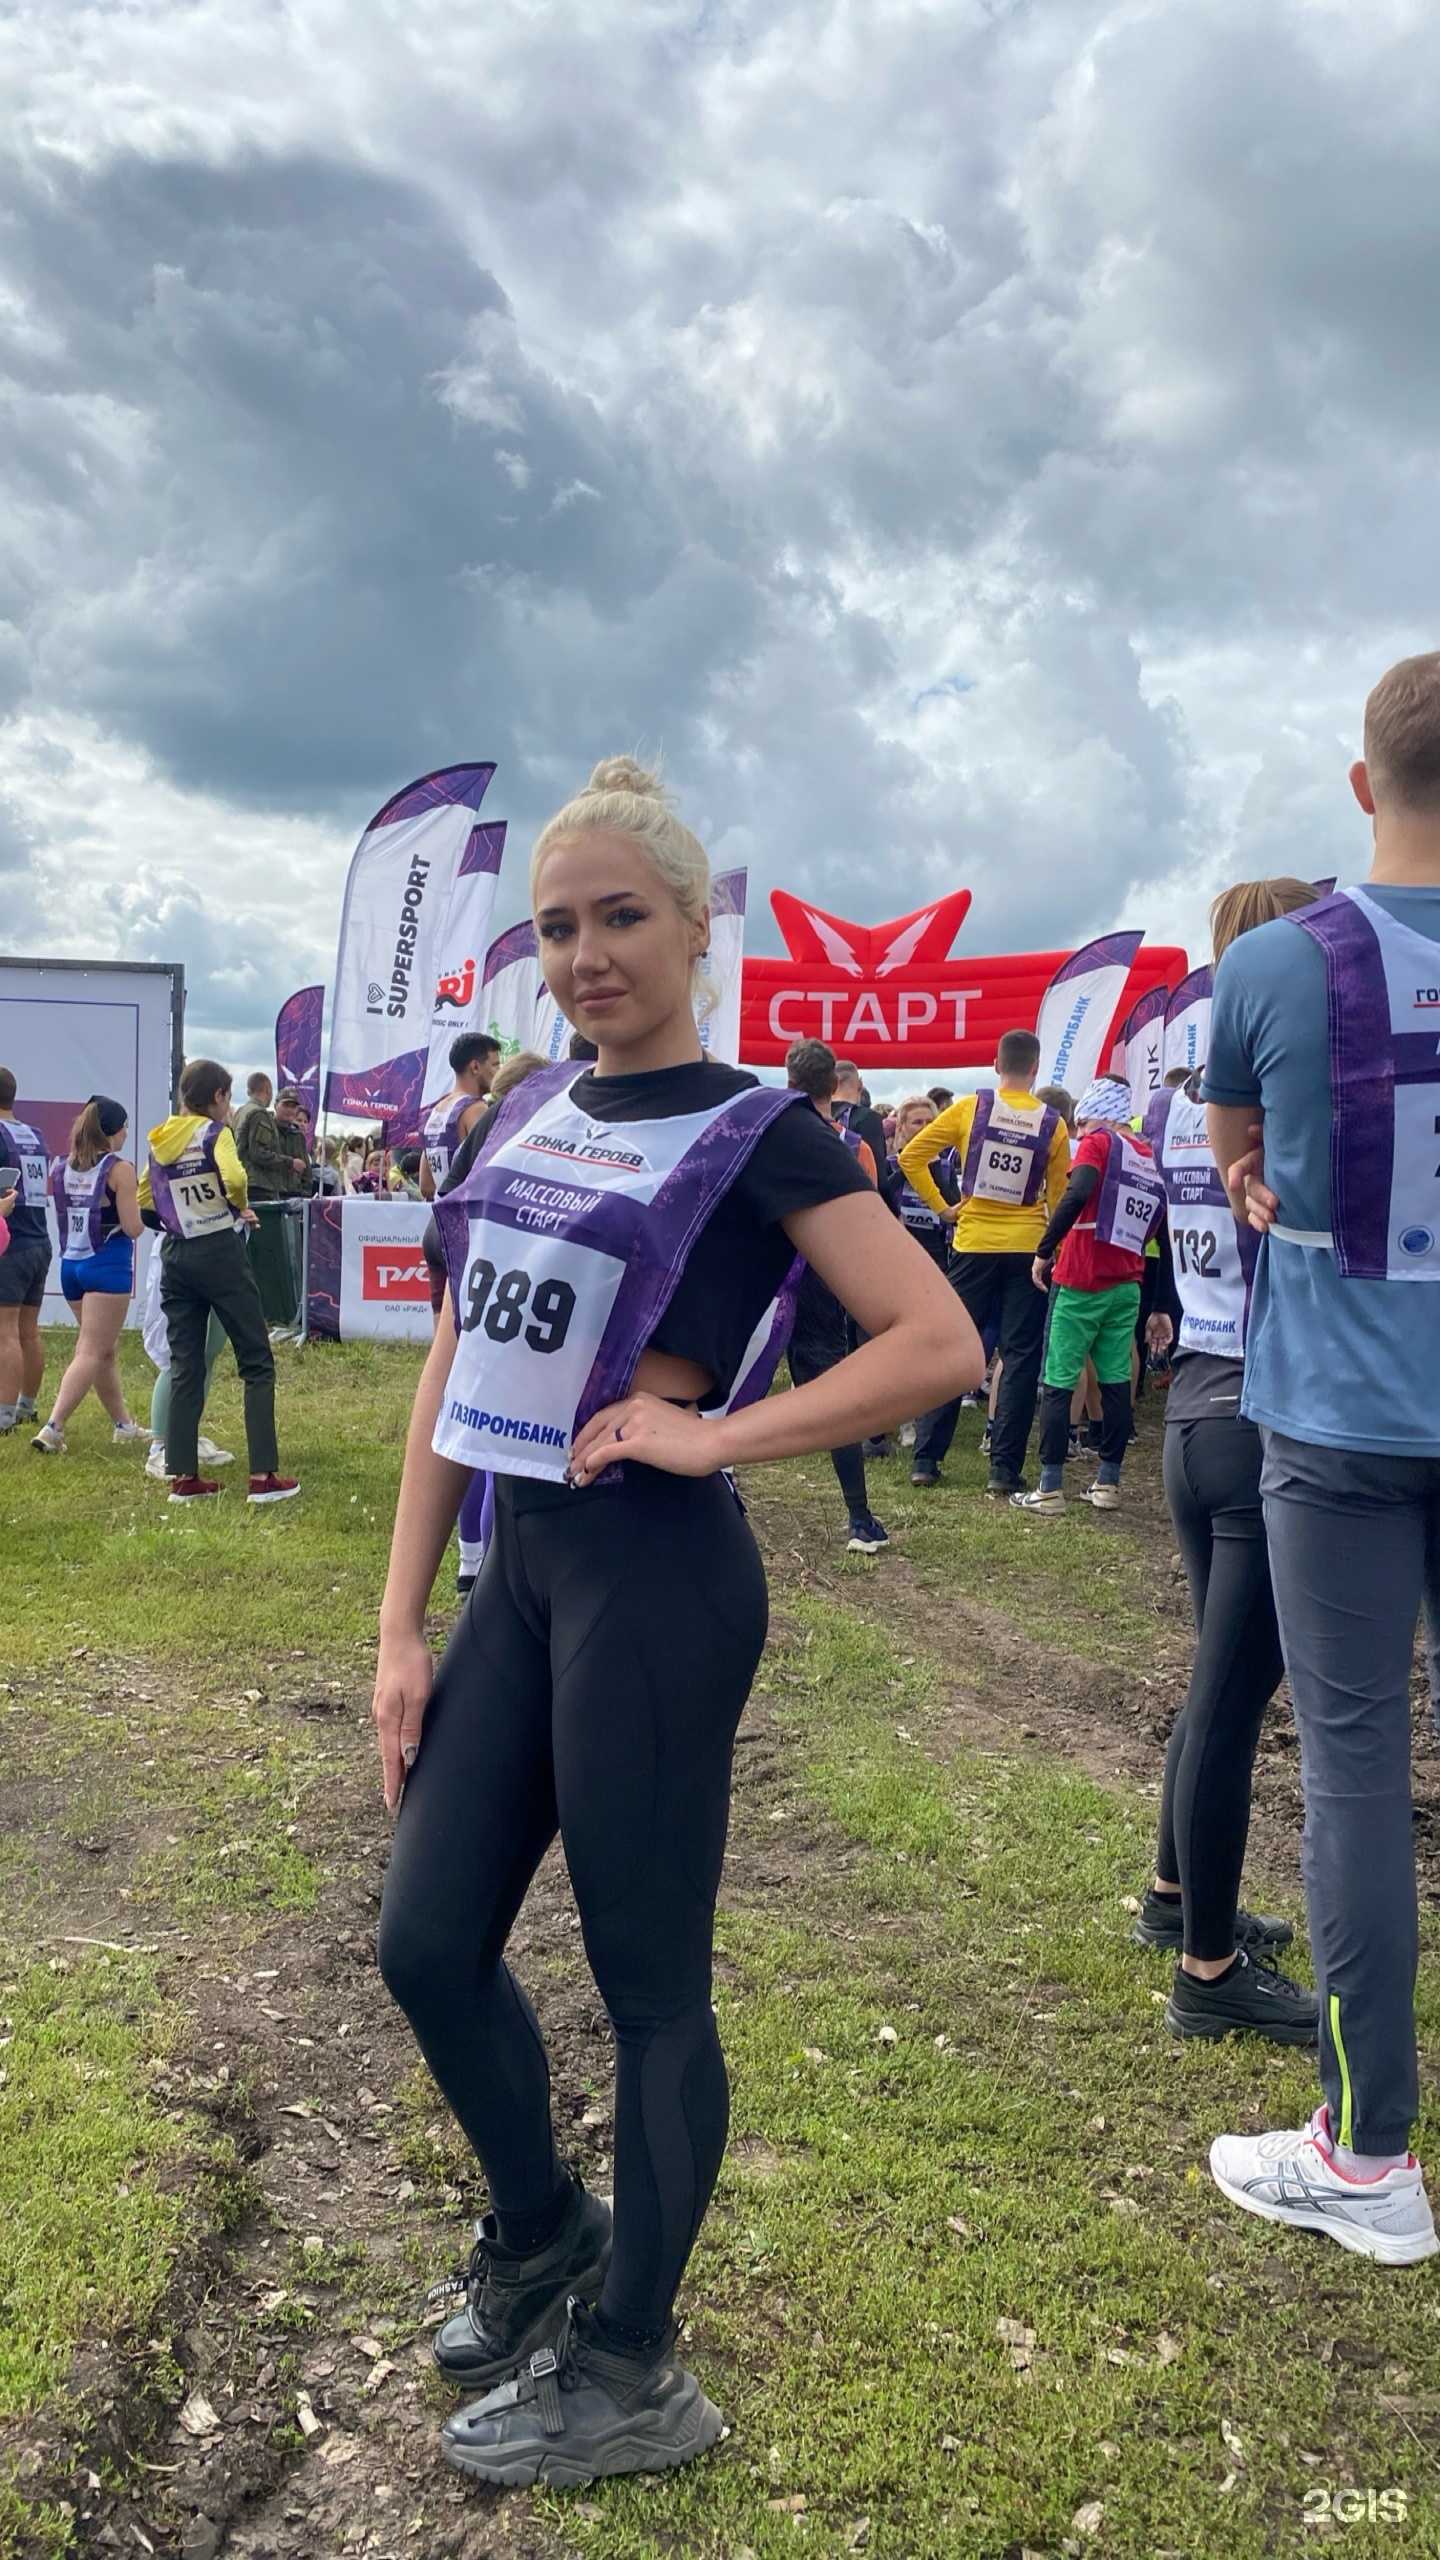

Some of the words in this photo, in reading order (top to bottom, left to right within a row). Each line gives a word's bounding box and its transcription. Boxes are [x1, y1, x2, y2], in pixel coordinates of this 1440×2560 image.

[386, 853, 431, 1019] SUPERSPORT
[366, 1006, 383, 1016] I
[768, 989, 983, 1042] СТАРТ
[1051, 995, 1091, 1087] ГАЗПРОМБАНК
[524, 1134, 576, 1155] ГОНКА
[579, 1145, 645, 1167] ГЕРОЕВ
[989, 1151, 1022, 1174] 633
[1172, 1167, 1211, 1185] МАССОВЫЙ
[180, 1182, 216, 1206] 715
[504, 1178, 604, 1213] МАССОВЫЙ
[1125, 1196, 1152, 1222] 632
[1181, 1186, 1203, 1201] СТАРТ
[515, 1205, 568, 1231] СТАРТ
[1173, 1229, 1221, 1278] 732
[461, 1258, 577, 1354] 989
[450, 1401, 568, 1448] ГАЗПРОМБАНК
